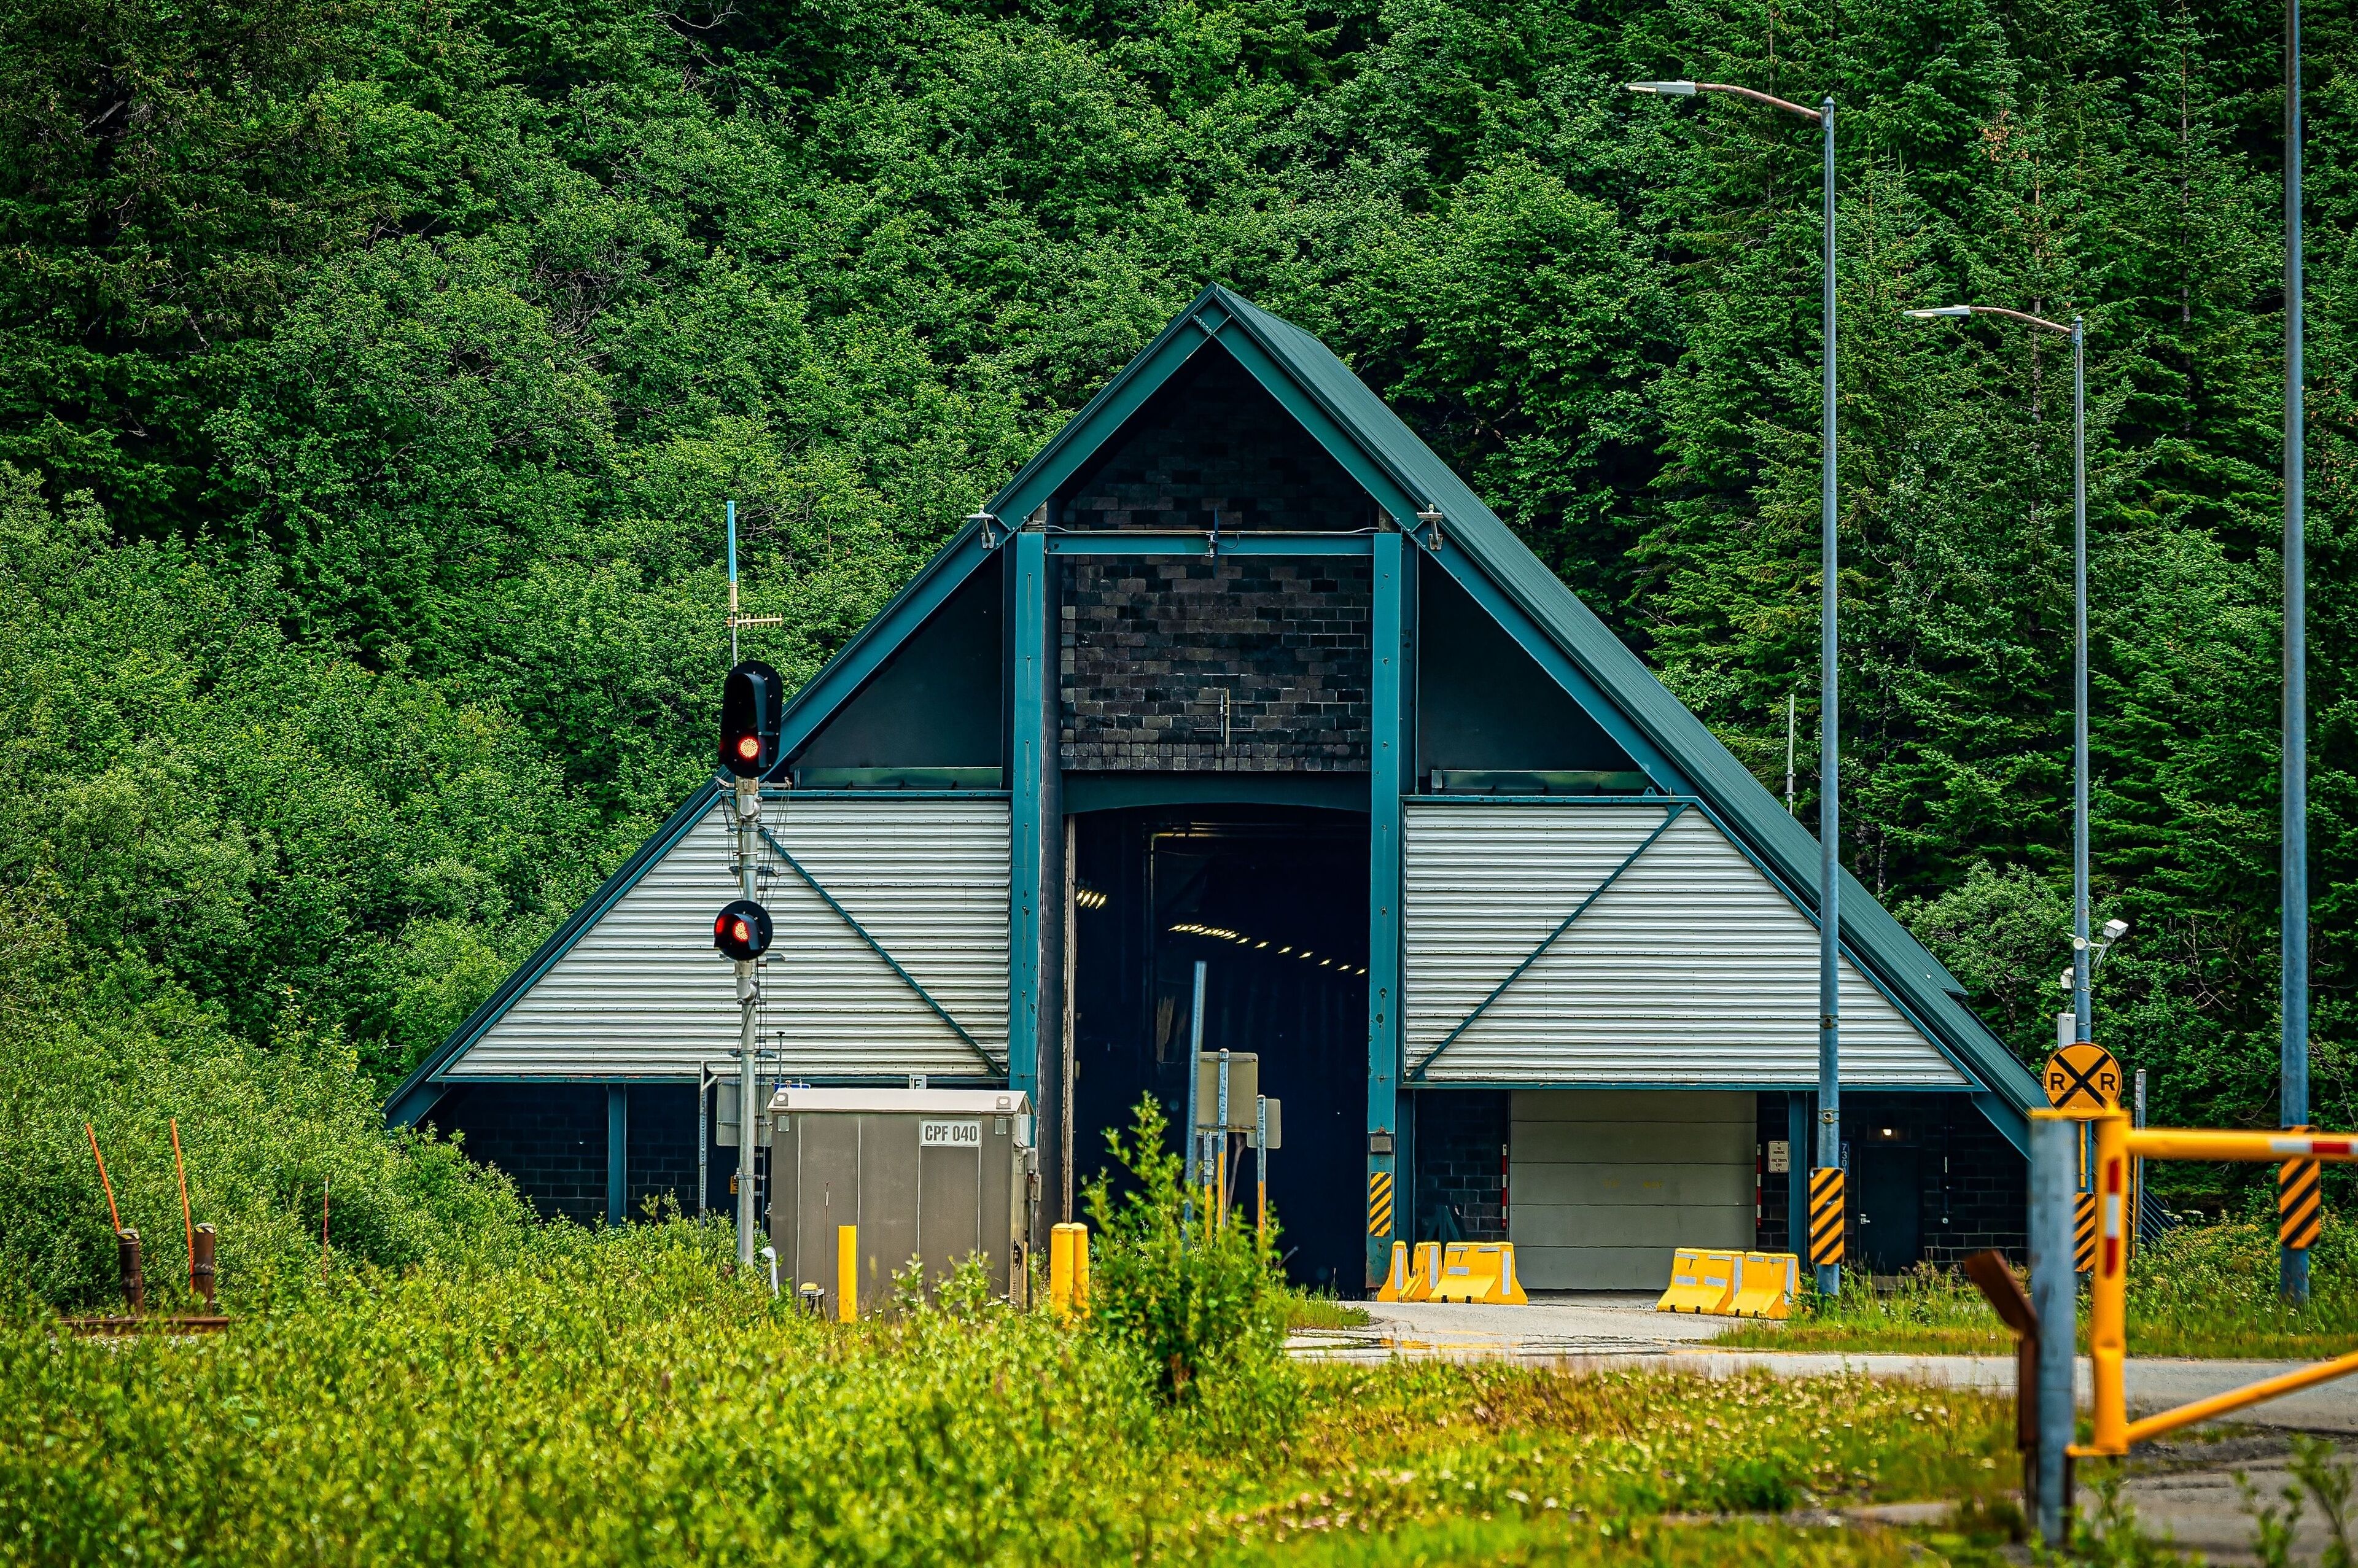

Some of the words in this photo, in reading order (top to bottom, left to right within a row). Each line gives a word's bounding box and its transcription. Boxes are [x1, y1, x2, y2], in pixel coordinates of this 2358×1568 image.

[2050, 1072, 2066, 1091] R
[2100, 1073, 2116, 1091] R
[925, 1125, 949, 1141] CPF
[952, 1125, 978, 1142] 040
